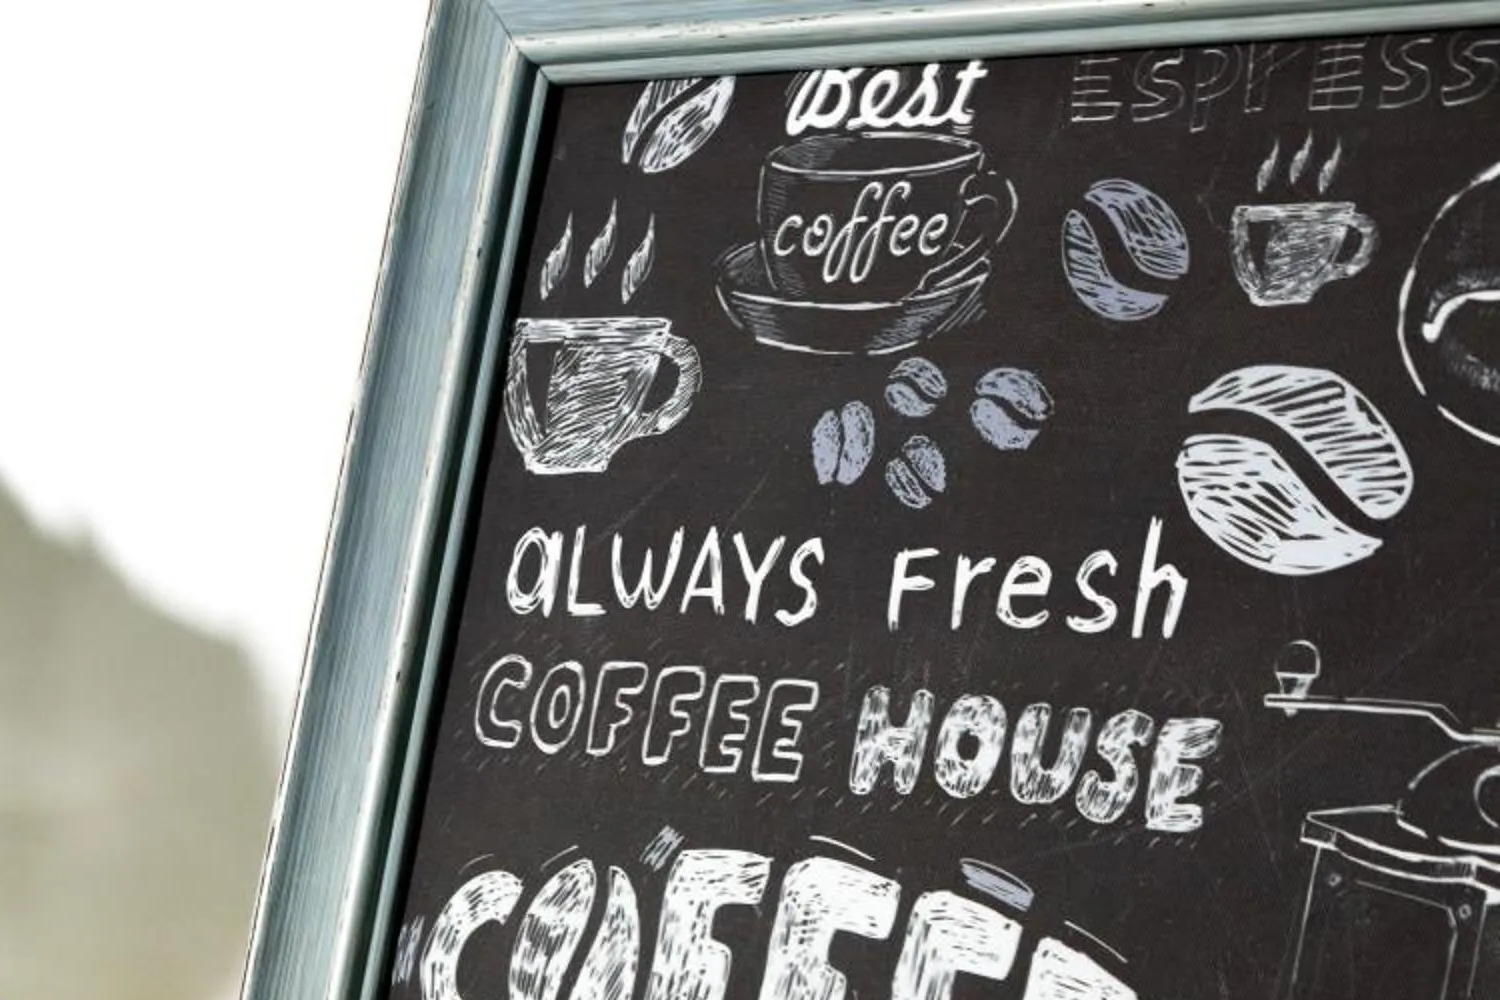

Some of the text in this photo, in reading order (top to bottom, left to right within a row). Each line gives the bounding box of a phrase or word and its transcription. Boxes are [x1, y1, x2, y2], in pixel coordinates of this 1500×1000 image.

[773, 180, 949, 284] coffee
[473, 654, 1224, 832] COFFEE HOUSE
